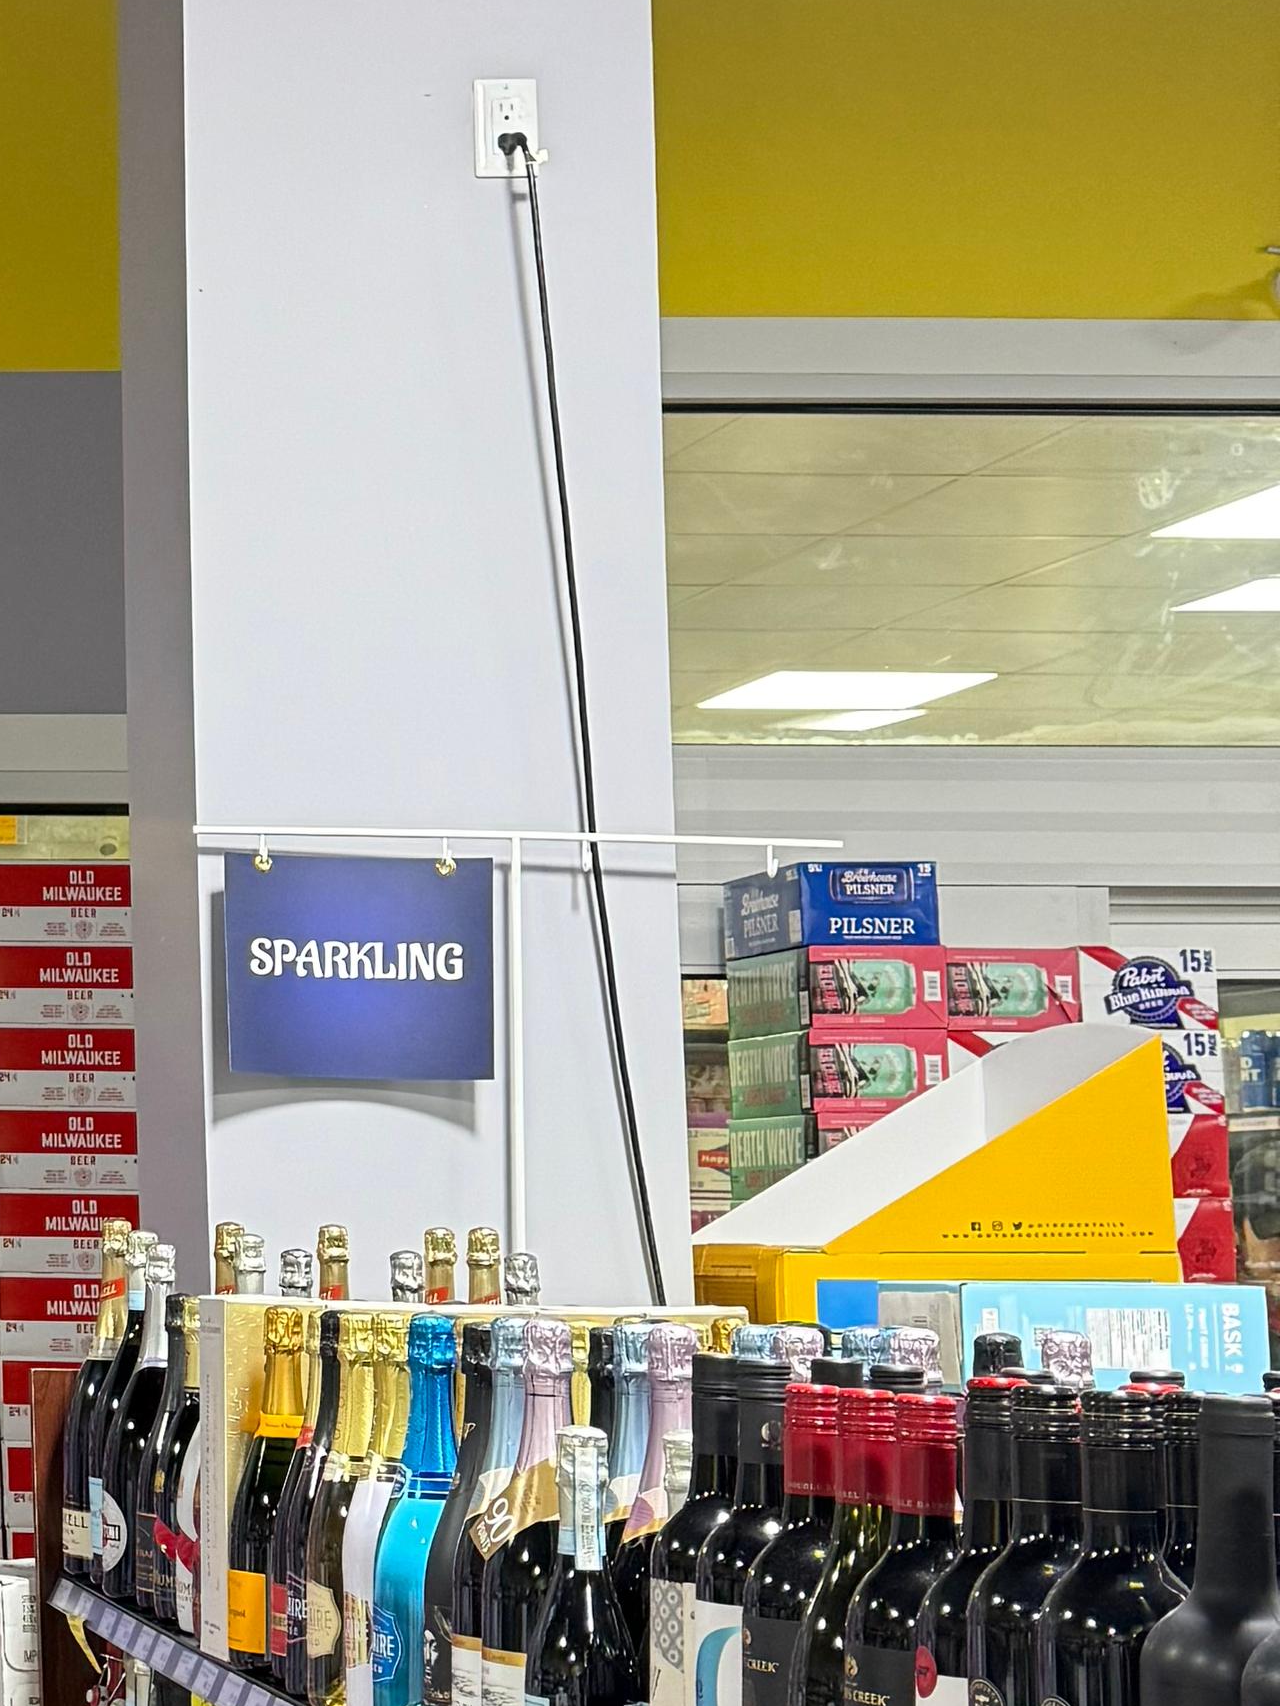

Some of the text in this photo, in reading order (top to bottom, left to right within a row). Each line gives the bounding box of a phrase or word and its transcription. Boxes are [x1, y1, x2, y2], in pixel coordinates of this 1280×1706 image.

[845, 883, 895, 896] PILSNER
[829, 918, 916, 935] PILSNER
[249, 937, 464, 981] SPARKLING
[1180, 949, 1202, 973] 15
[1120, 967, 1166, 987] Pabst
[1183, 1033, 1206, 1057] 15
[484, 1497, 515, 1543] 90
